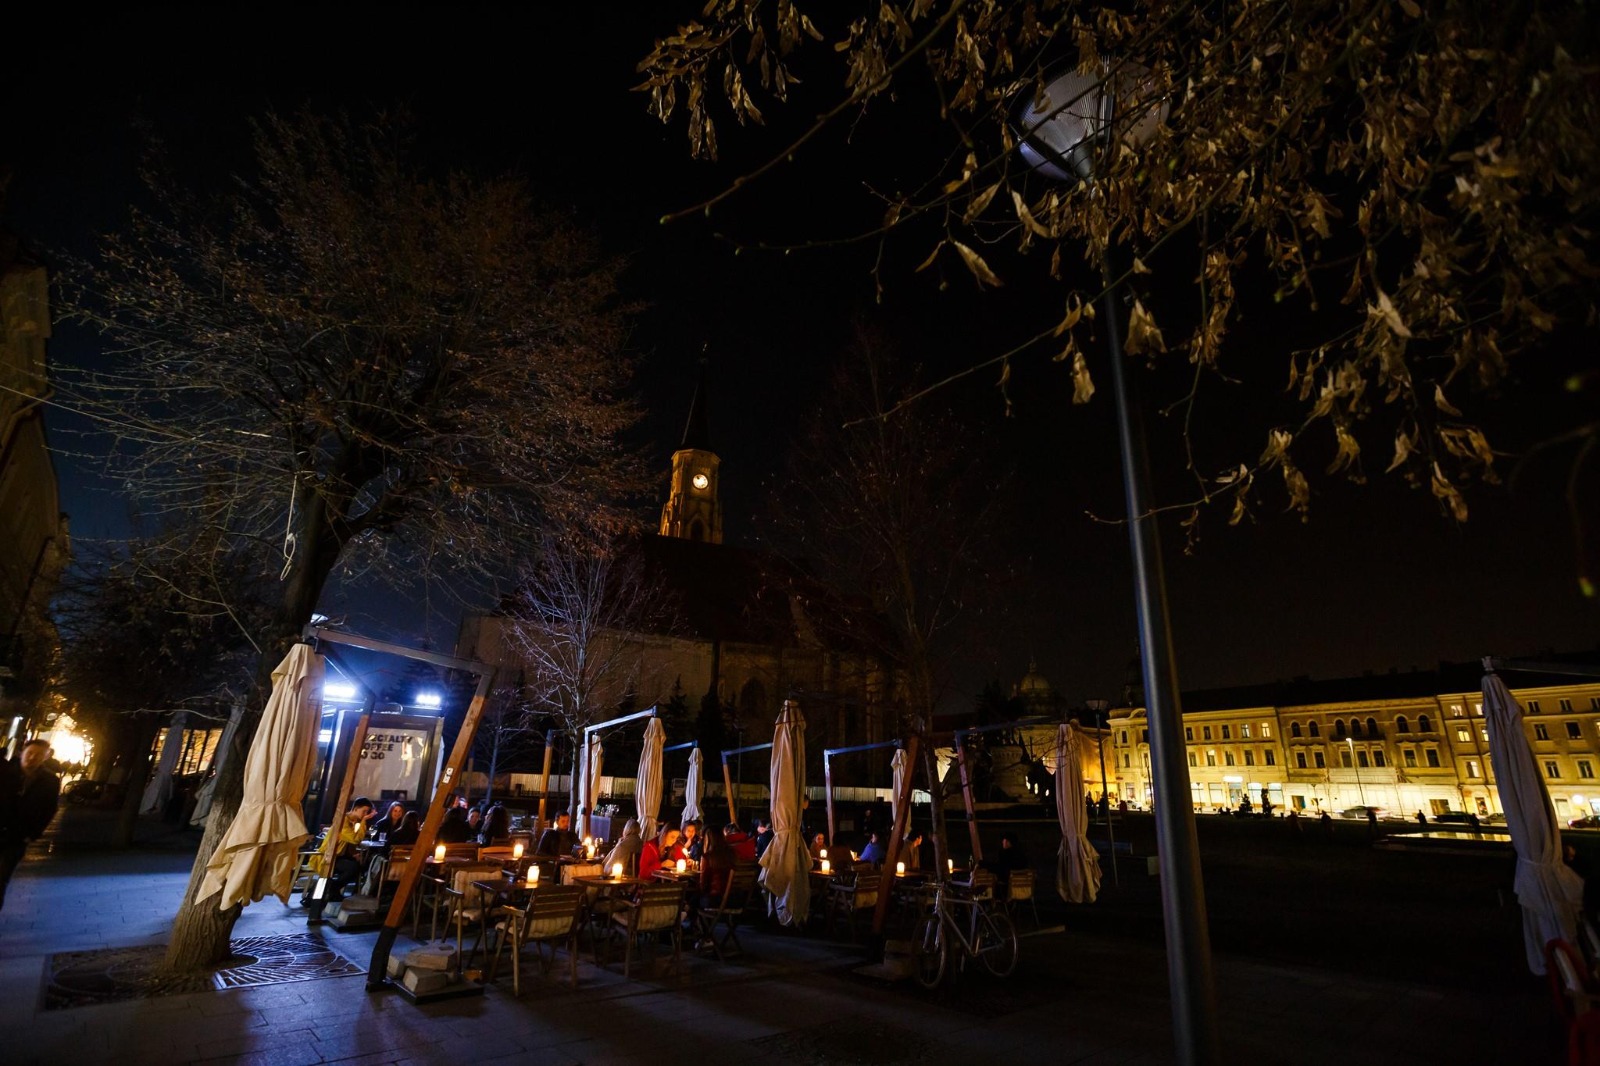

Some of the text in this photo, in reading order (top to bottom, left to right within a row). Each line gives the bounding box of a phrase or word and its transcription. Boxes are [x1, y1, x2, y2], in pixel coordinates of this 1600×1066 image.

[366, 734, 413, 743] ECIALTY
[363, 742, 394, 751] OFFEE
[360, 751, 385, 759] O GO
